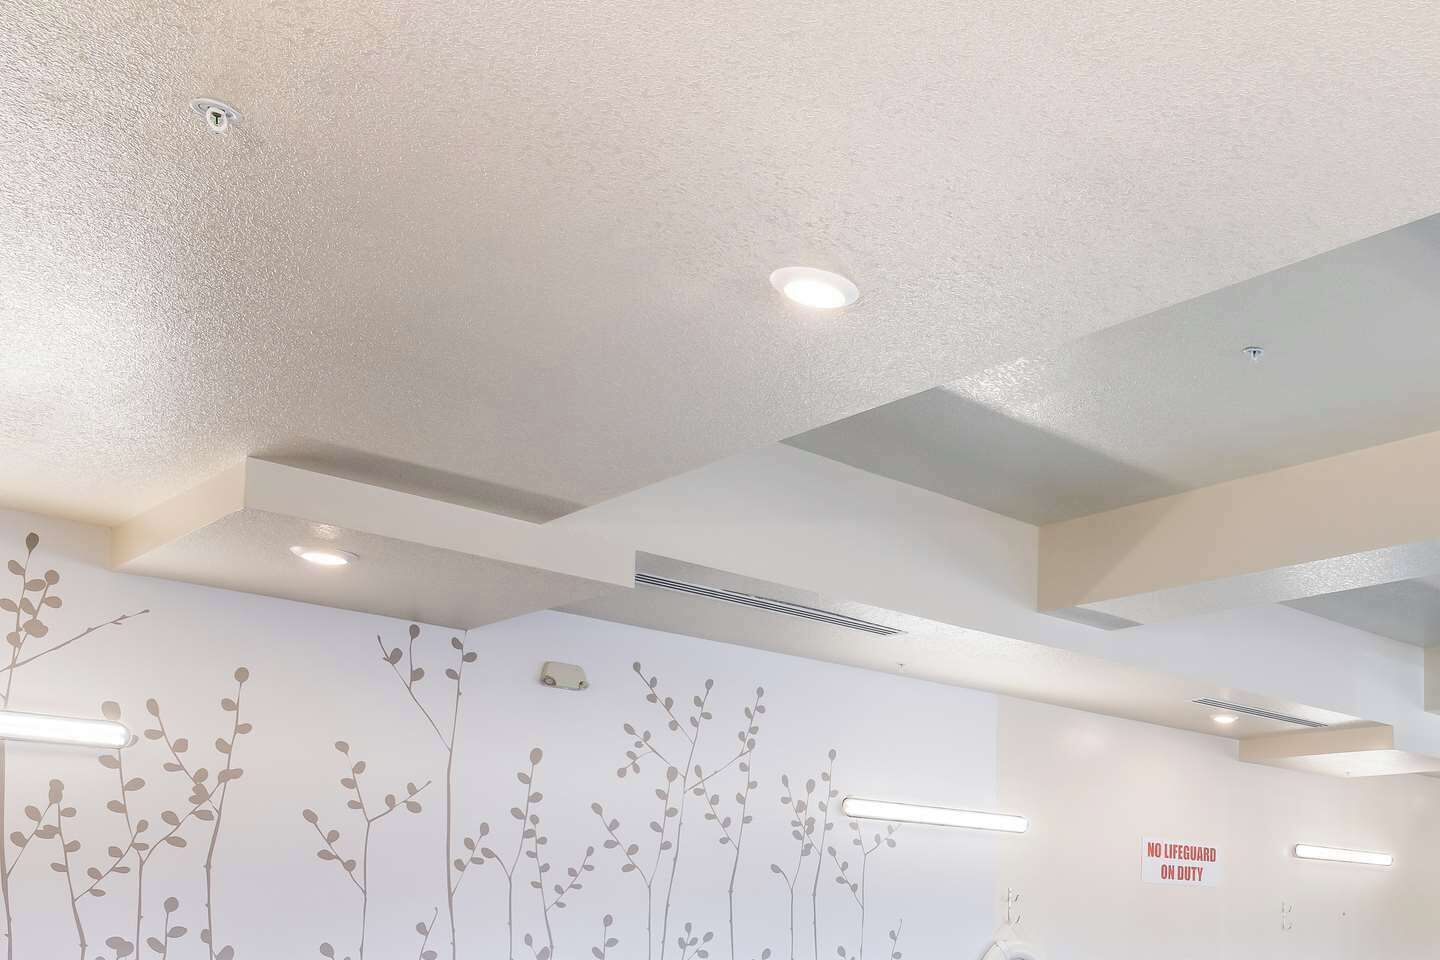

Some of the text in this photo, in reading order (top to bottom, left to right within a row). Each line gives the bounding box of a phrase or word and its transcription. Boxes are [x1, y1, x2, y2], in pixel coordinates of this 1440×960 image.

[1147, 842, 1217, 862] NO LIFEGUARD
[1160, 864, 1203, 881] ON DUTY
